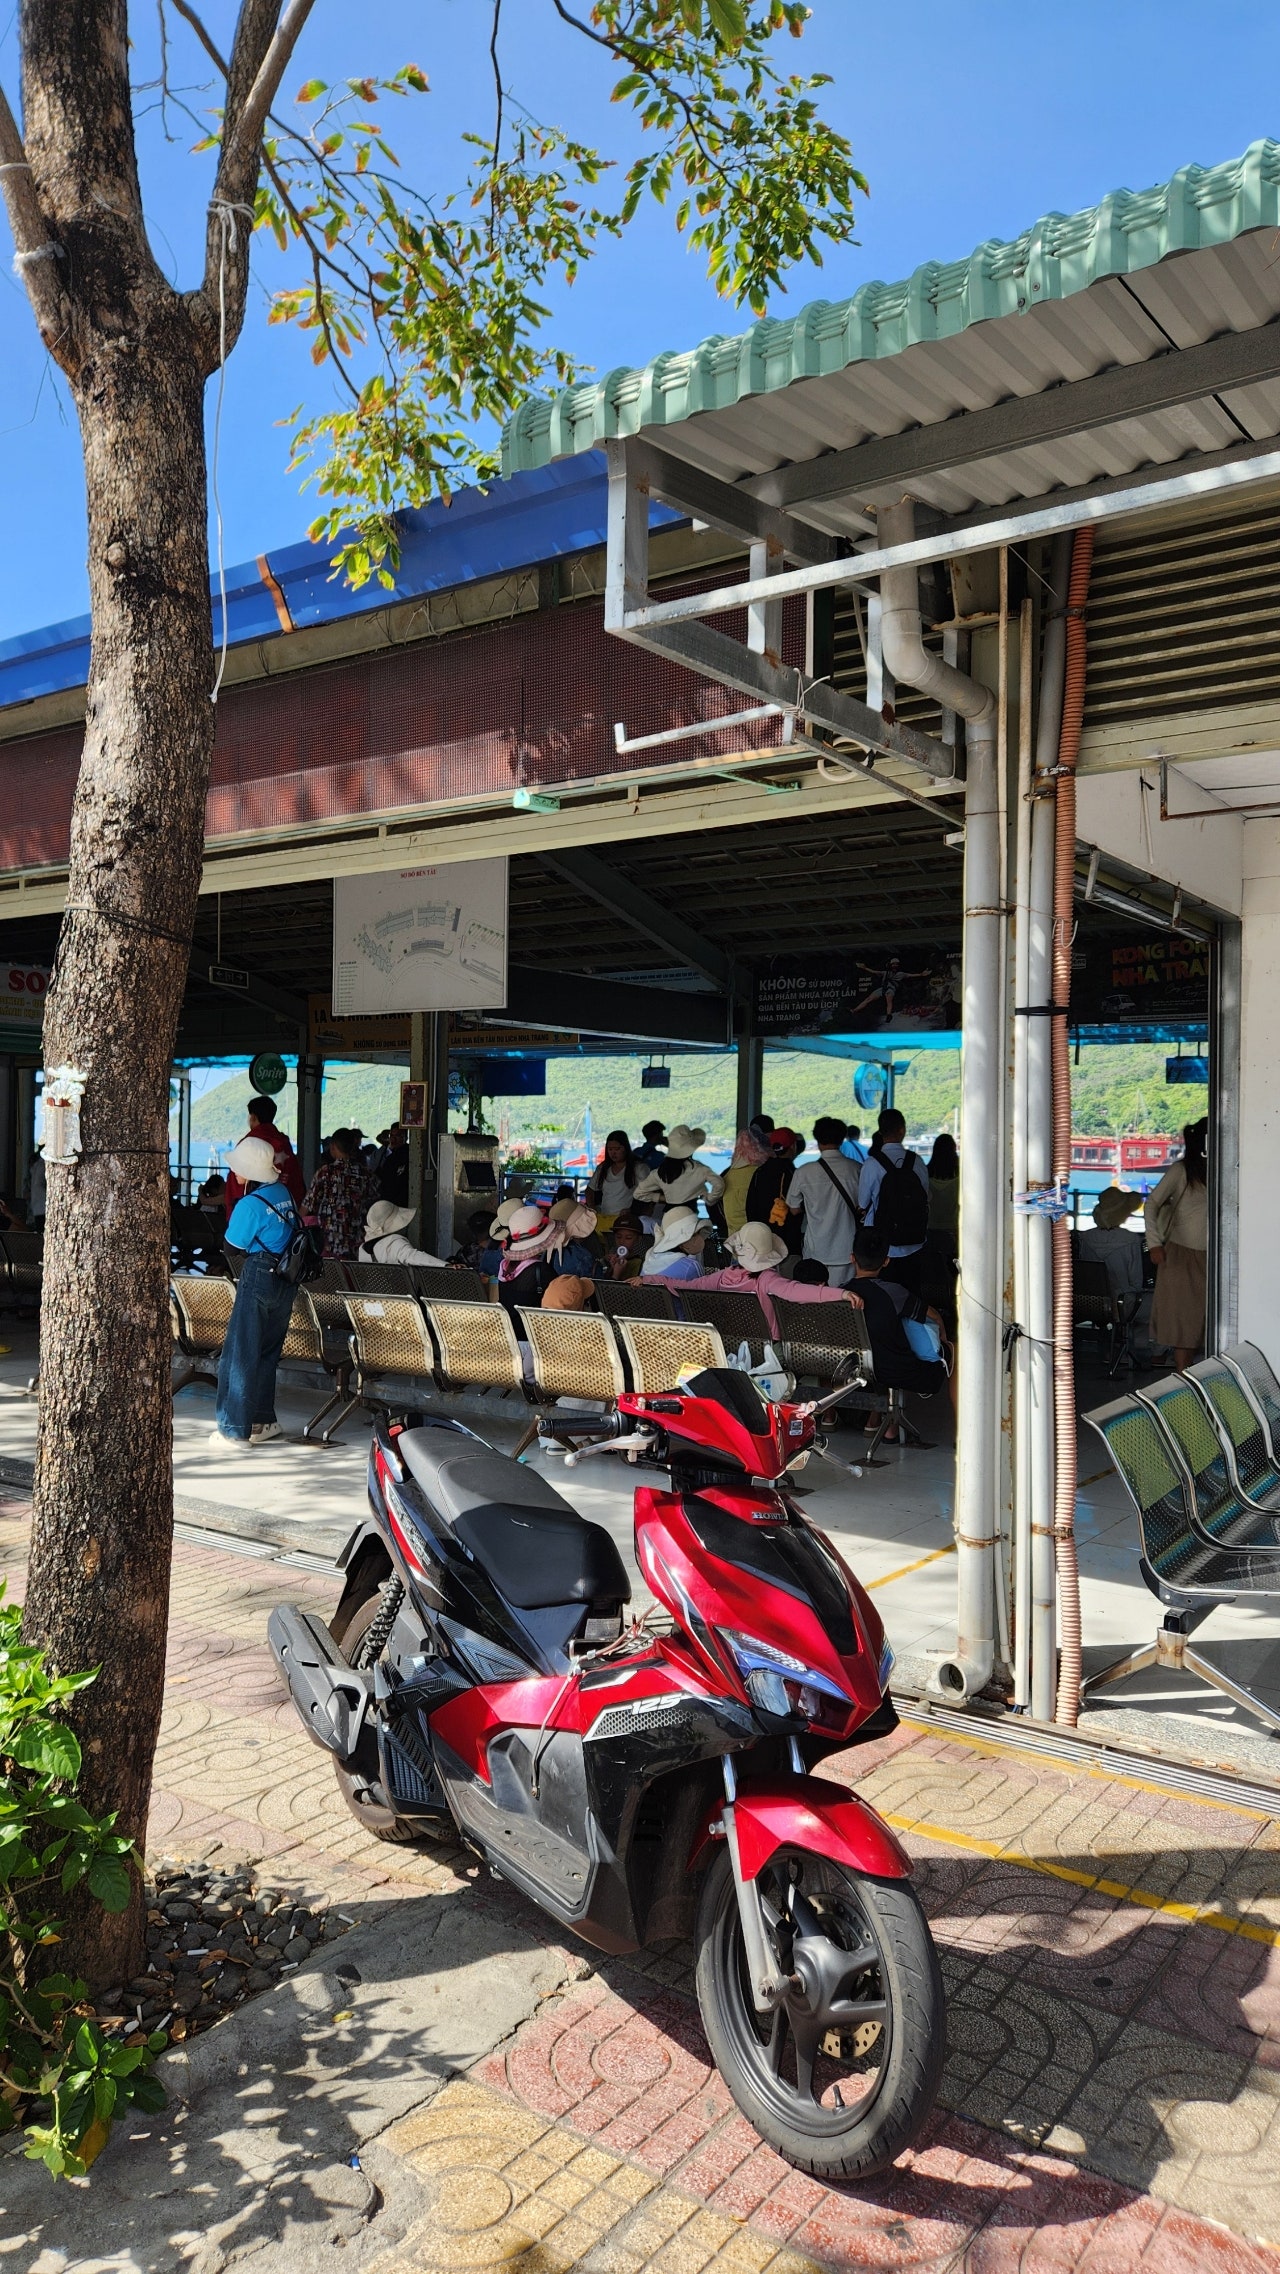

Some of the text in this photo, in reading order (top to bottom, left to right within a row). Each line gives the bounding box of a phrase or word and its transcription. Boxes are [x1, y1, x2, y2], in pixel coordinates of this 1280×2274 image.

[1112, 942, 1165, 965] KONG
[8, 969, 51, 994] SO
[759, 975, 807, 991] KHÔNG
[1112, 964, 1160, 986] NHA
[807, 1002, 819, 1010] DU
[758, 1013, 801, 1022] NHA TRANG
[256, 1065, 285, 1080] Sprite
[631, 1692, 682, 1715] 125
